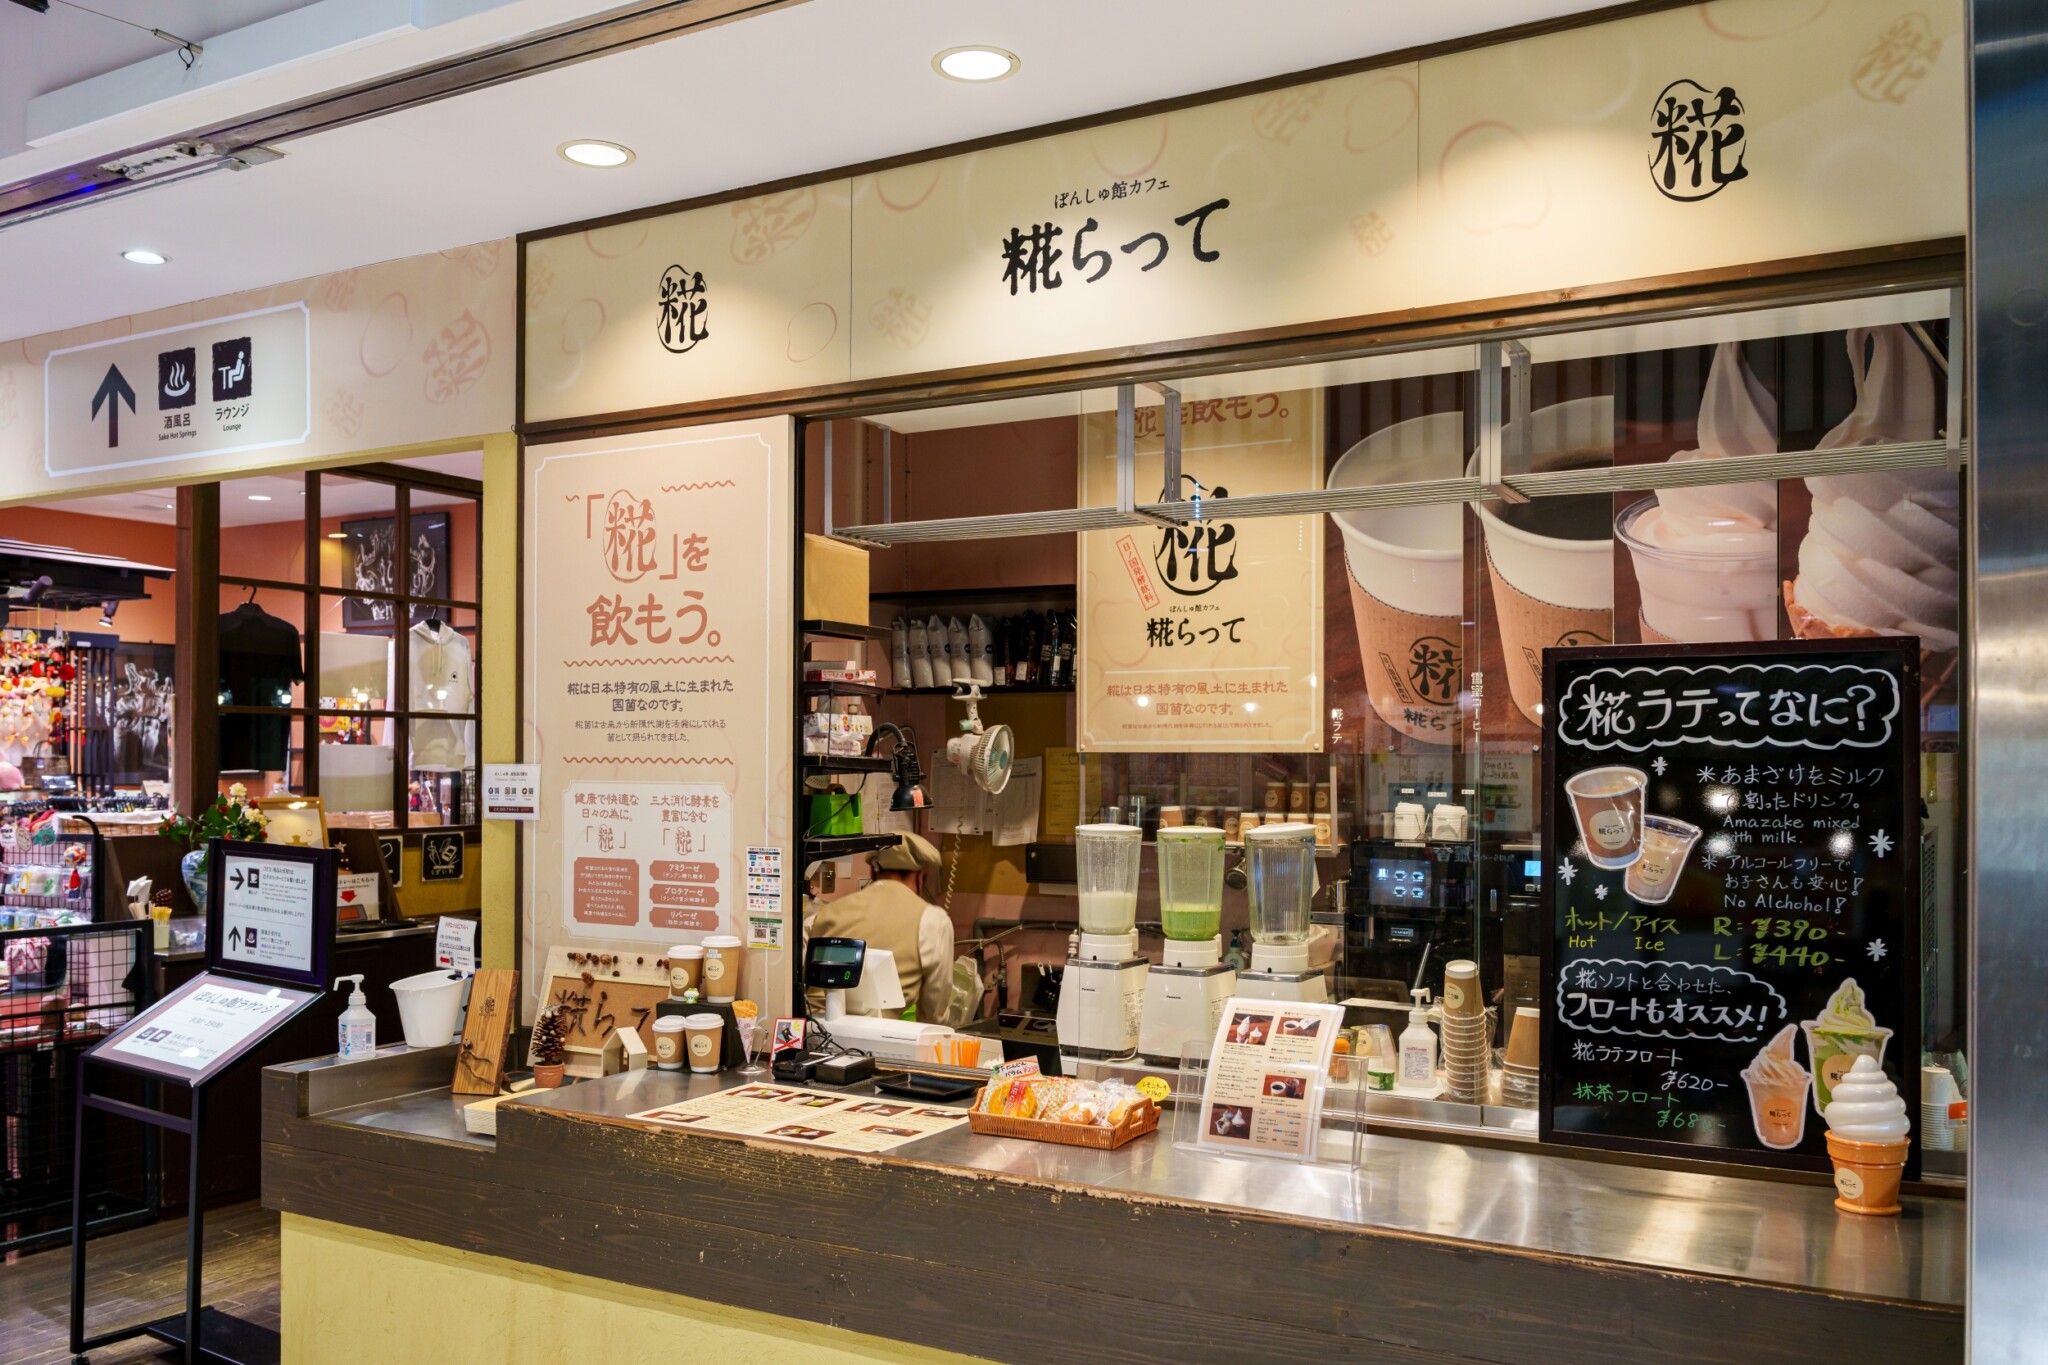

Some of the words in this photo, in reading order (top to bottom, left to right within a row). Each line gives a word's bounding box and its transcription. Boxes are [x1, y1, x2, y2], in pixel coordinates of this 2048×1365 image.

[1651, 87, 1749, 190] 糀
[1054, 177, 1170, 209] ぽんしゅ館カフェ
[1002, 198, 1230, 296] 糀らって
[657, 271, 709, 345] 糀
[215, 403, 250, 421] ラウンジ
[164, 412, 191, 429] 酒風呂
[222, 423, 242, 432] Lounge
[170, 431, 179, 439] Hot
[179, 429, 198, 439] Springs
[586, 590, 721, 648] 飲もう。
[1146, 616, 1246, 648] 糀らって
[567, 679, 734, 696] 糀は日本特有の風土に生まれた
[1106, 681, 1289, 697] 糀は日本特有の風土に生まれた
[612, 698, 685, 713] 国菌なのです。
[1156, 702, 1234, 716] 国菌なのです。
[1577, 684, 1877, 739] 糀ラテってなに?
[1331, 708, 1344, 745] 糀ラテ
[574, 792, 640, 806] 健康で快適な
[650, 795, 720, 809] 三大消化酵素を
[662, 809, 708, 823] 豊富に含む
[1723, 814, 1805, 829] Amazake
[1813, 815, 1861, 829] mixed
[668, 864, 701, 873] アミラーゼ
[1723, 893, 1747, 909] No
[1568, 935, 1598, 949] Hot
[1634, 936, 1666, 952] Ice
[1572, 1038, 1684, 1068] 糀ラテフロート
[1572, 1081, 1681, 1108] 抹茶フロート
